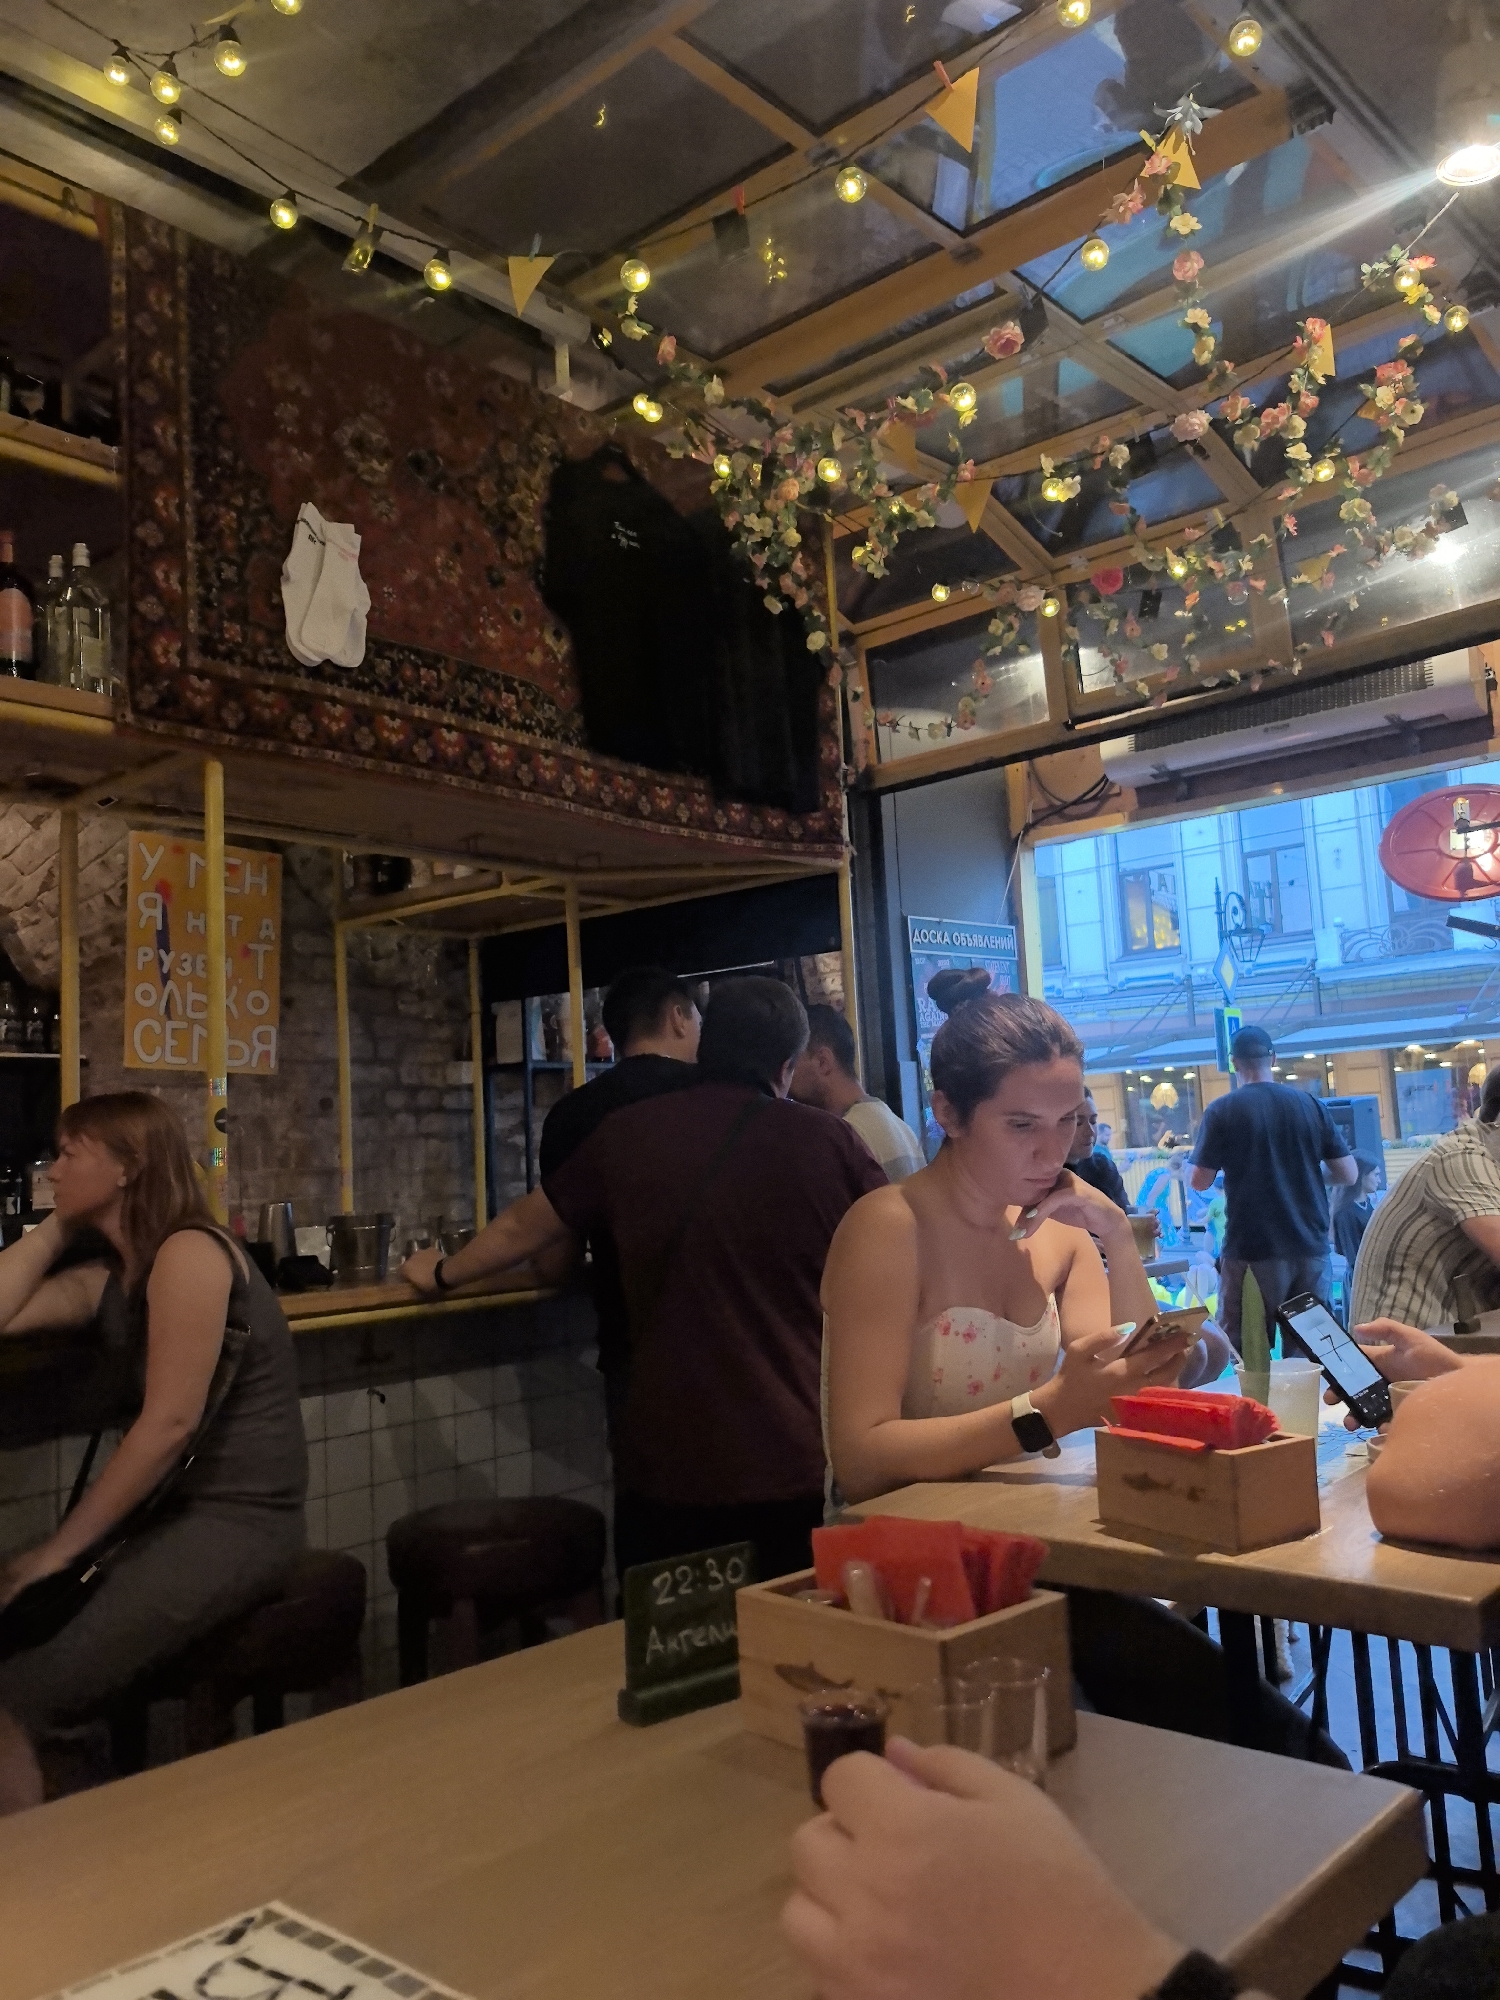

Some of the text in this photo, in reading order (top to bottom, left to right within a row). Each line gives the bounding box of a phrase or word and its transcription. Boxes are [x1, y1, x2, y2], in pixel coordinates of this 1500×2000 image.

[138, 842, 165, 881] У
[137, 891, 163, 931] Я
[186, 910, 244, 938] НТ
[912, 928, 1014, 951] ДОСКА ОБЪЯВЛЕНИЙ
[247, 943, 274, 981] Т
[652, 1556, 744, 1605] 22:30
